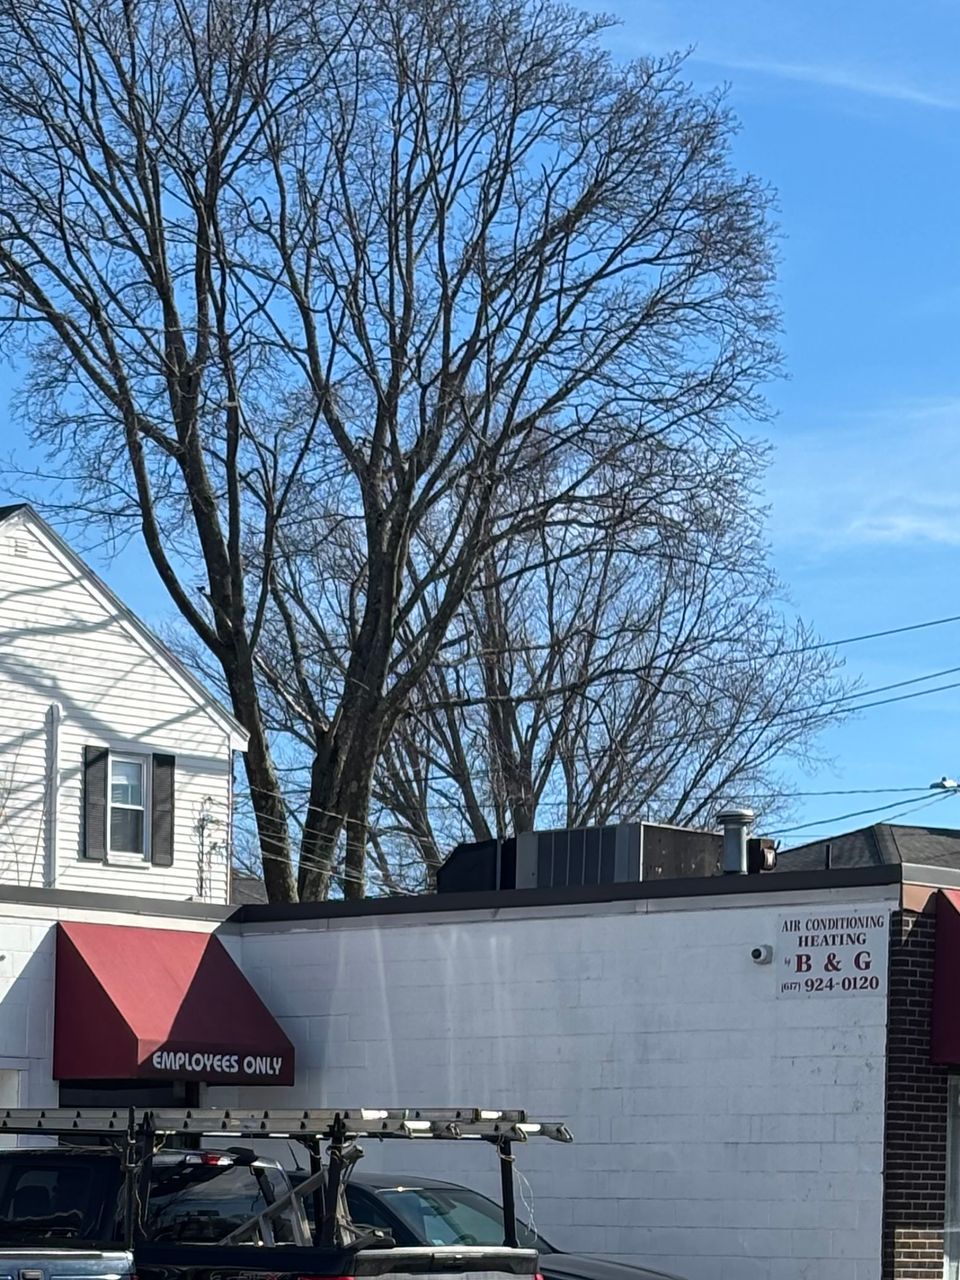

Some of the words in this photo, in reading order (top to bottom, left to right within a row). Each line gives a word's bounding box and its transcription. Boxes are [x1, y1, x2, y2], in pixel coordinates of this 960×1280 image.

[781, 920, 801, 932] AIR
[805, 915, 884, 931] CONDITIONING
[798, 933, 866, 947] HEATING
[795, 954, 812, 973] B
[824, 952, 842, 972] &
[854, 951, 872, 971] G
[804, 976, 880, 993] 924-0120
[153, 1051, 239, 1073] EMPLOYEES
[243, 1056, 282, 1075] ONLY
